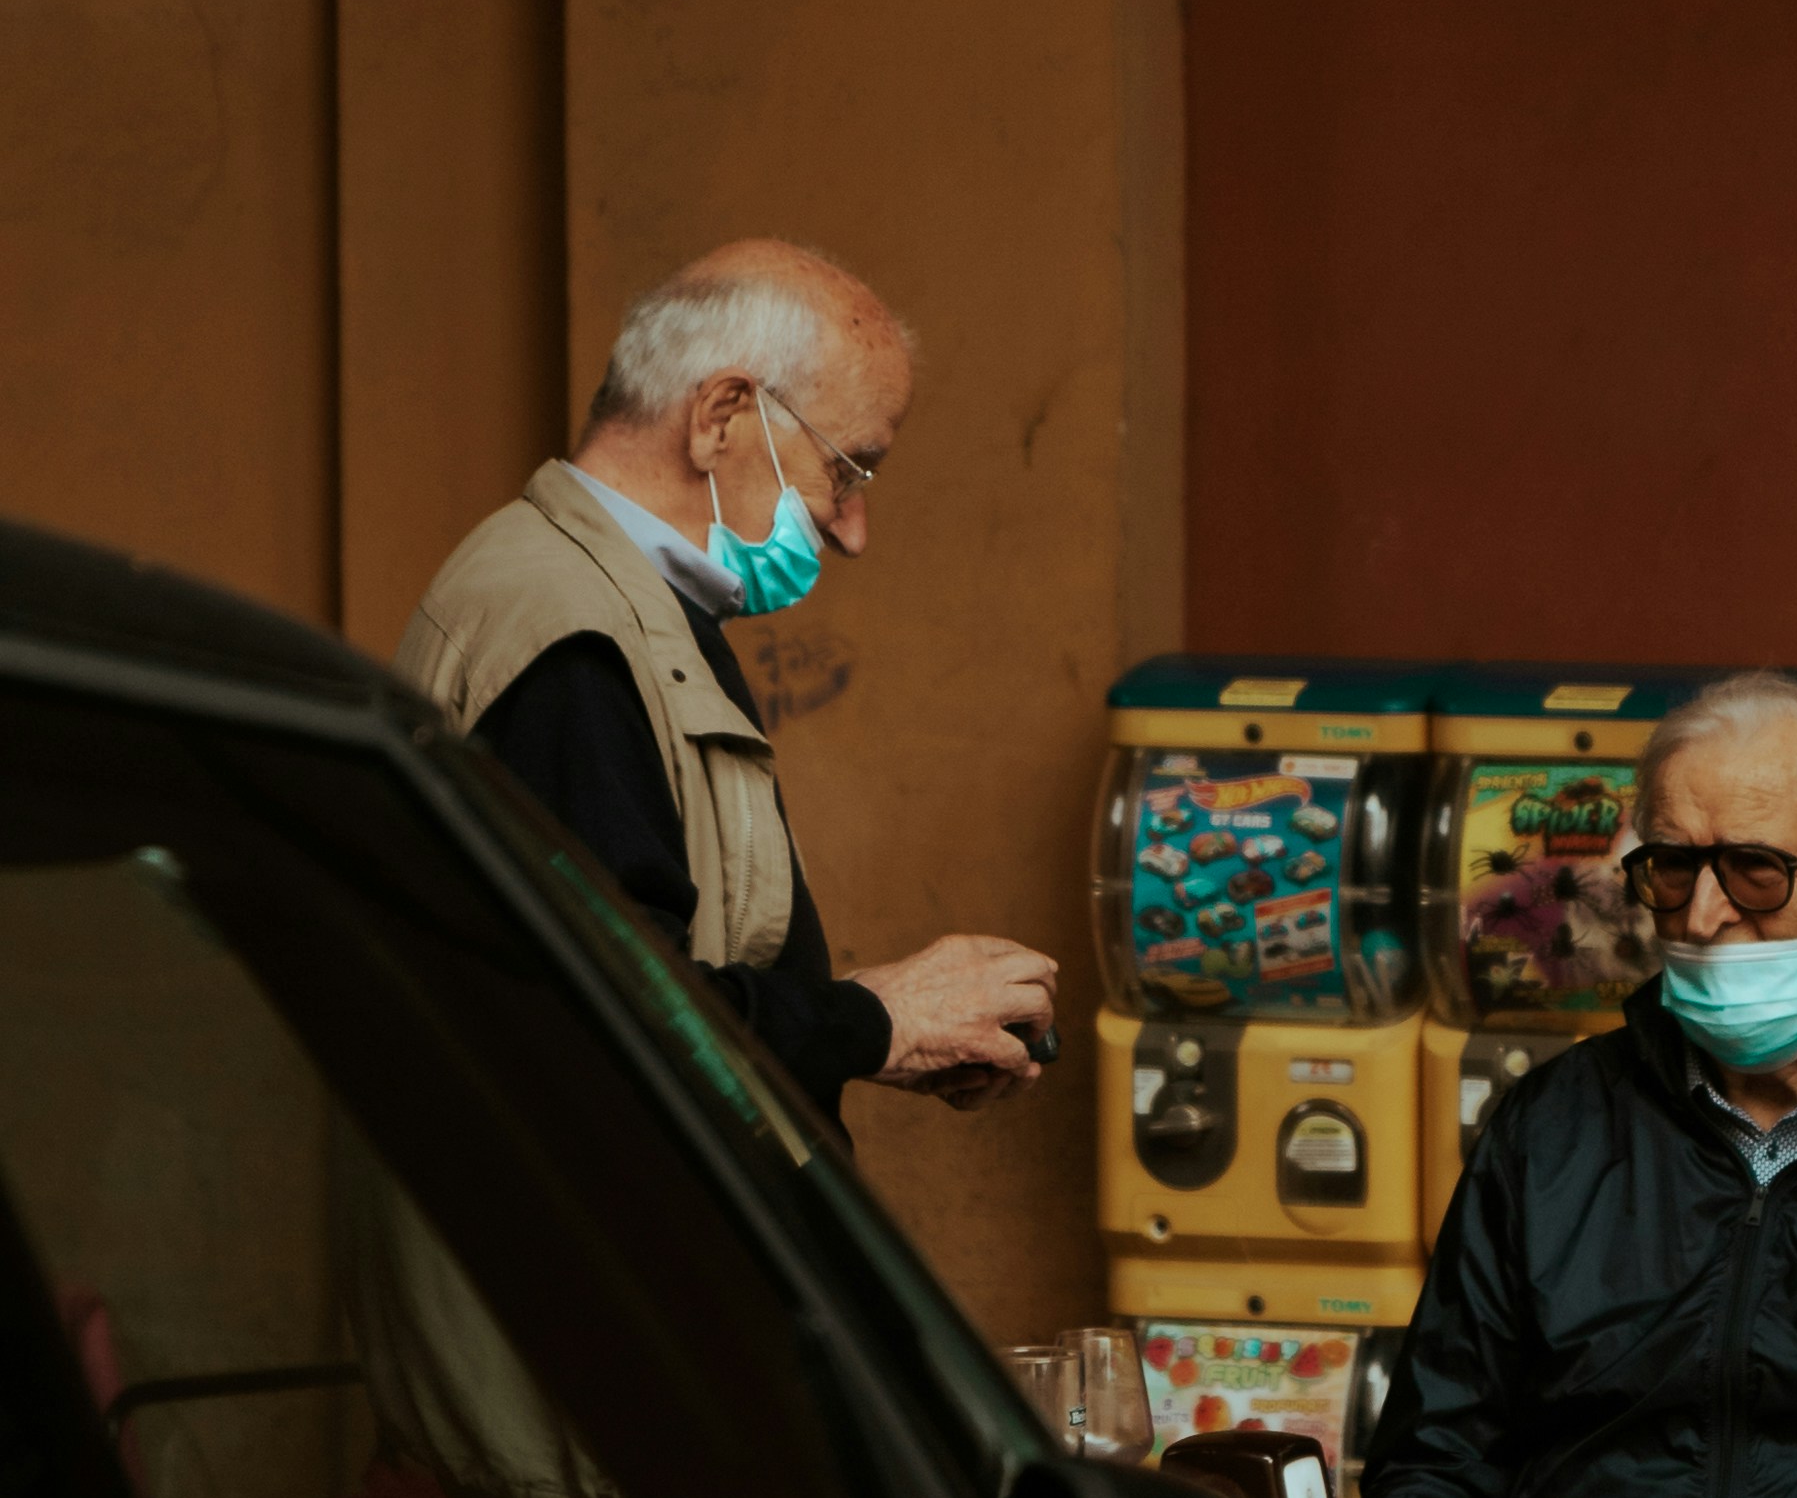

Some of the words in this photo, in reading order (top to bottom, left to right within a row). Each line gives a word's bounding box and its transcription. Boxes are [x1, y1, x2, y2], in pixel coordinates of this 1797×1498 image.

[1232, 813, 1272, 828] CARS
[1513, 795, 1621, 836] SPIDER
[1318, 1297, 1372, 1314] TOMY
